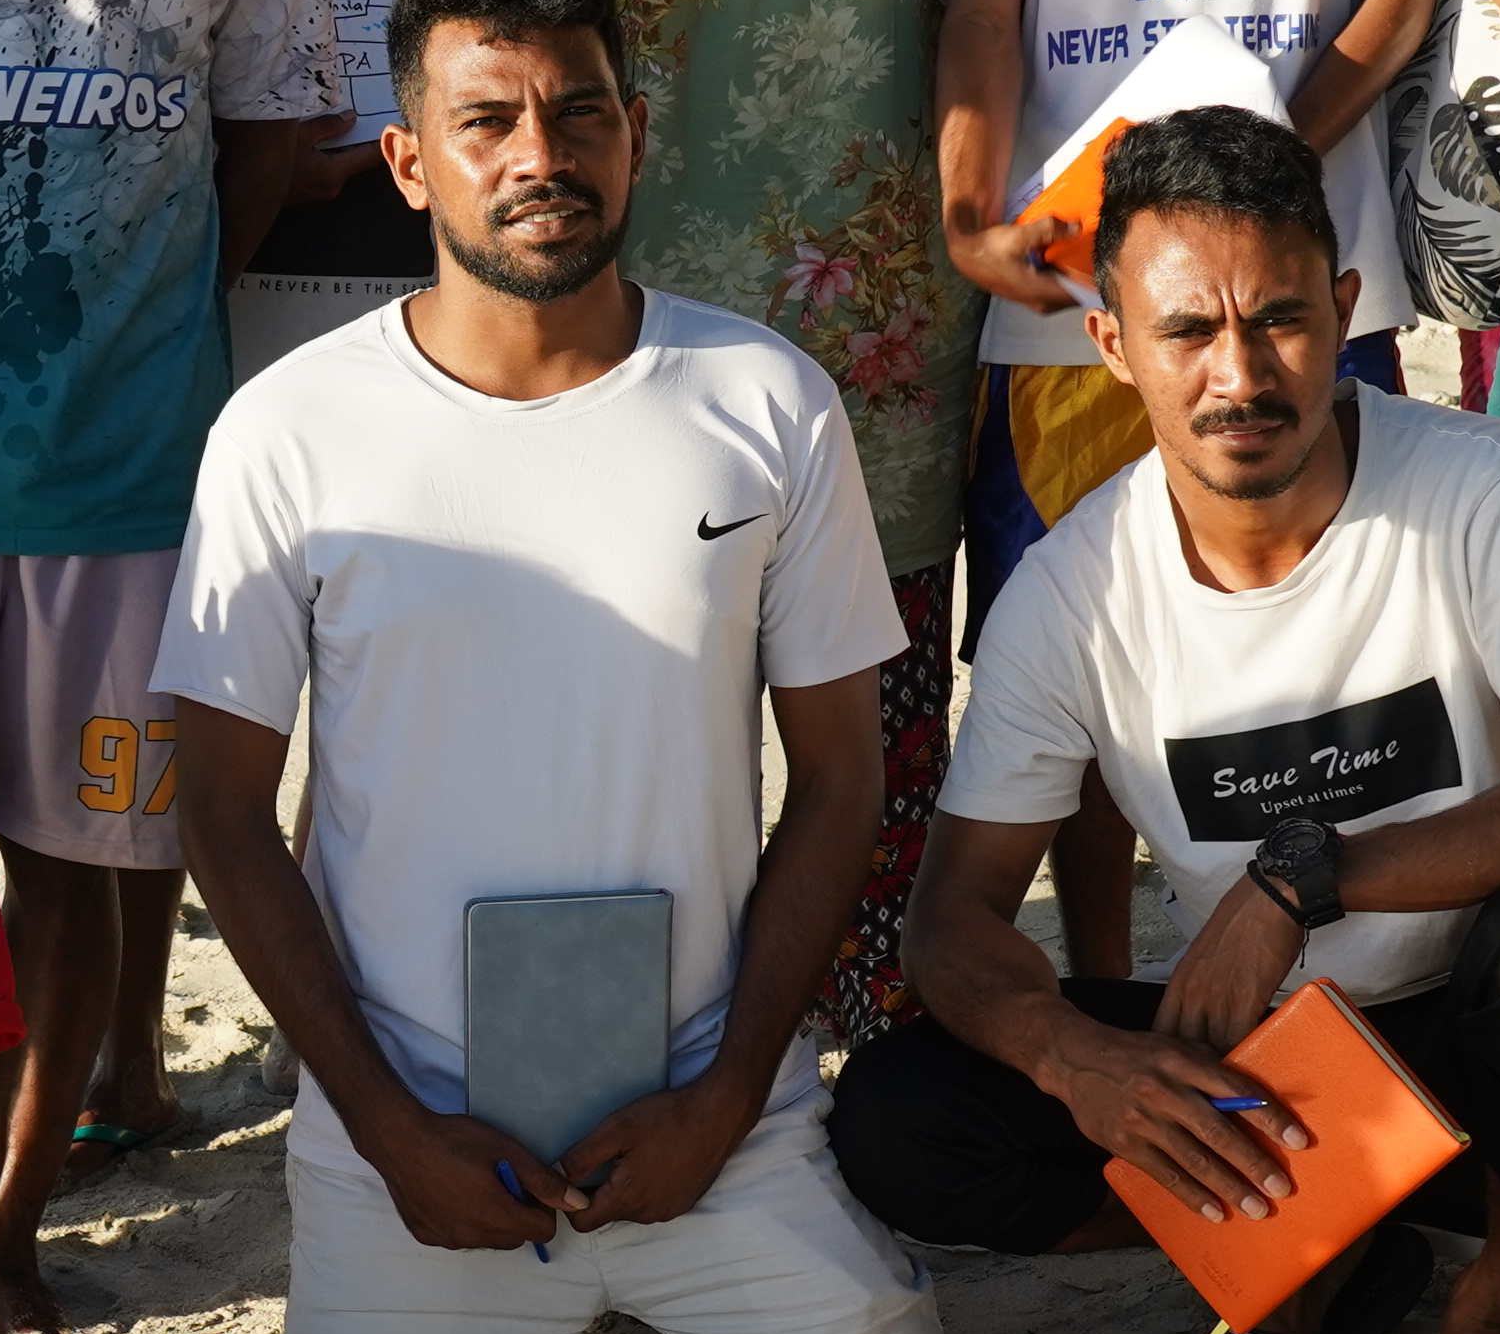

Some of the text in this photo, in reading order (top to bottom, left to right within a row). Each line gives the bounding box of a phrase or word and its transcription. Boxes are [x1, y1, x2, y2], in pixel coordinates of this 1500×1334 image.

[1048, 24, 1129, 70] NEVER
[259, 279, 320, 293] NEVER
[334, 282, 352, 294] BE
[364, 283, 392, 295] THE
[1213, 737, 1400, 799] Save Time
[1259, 781, 1365, 817] Upset at times
